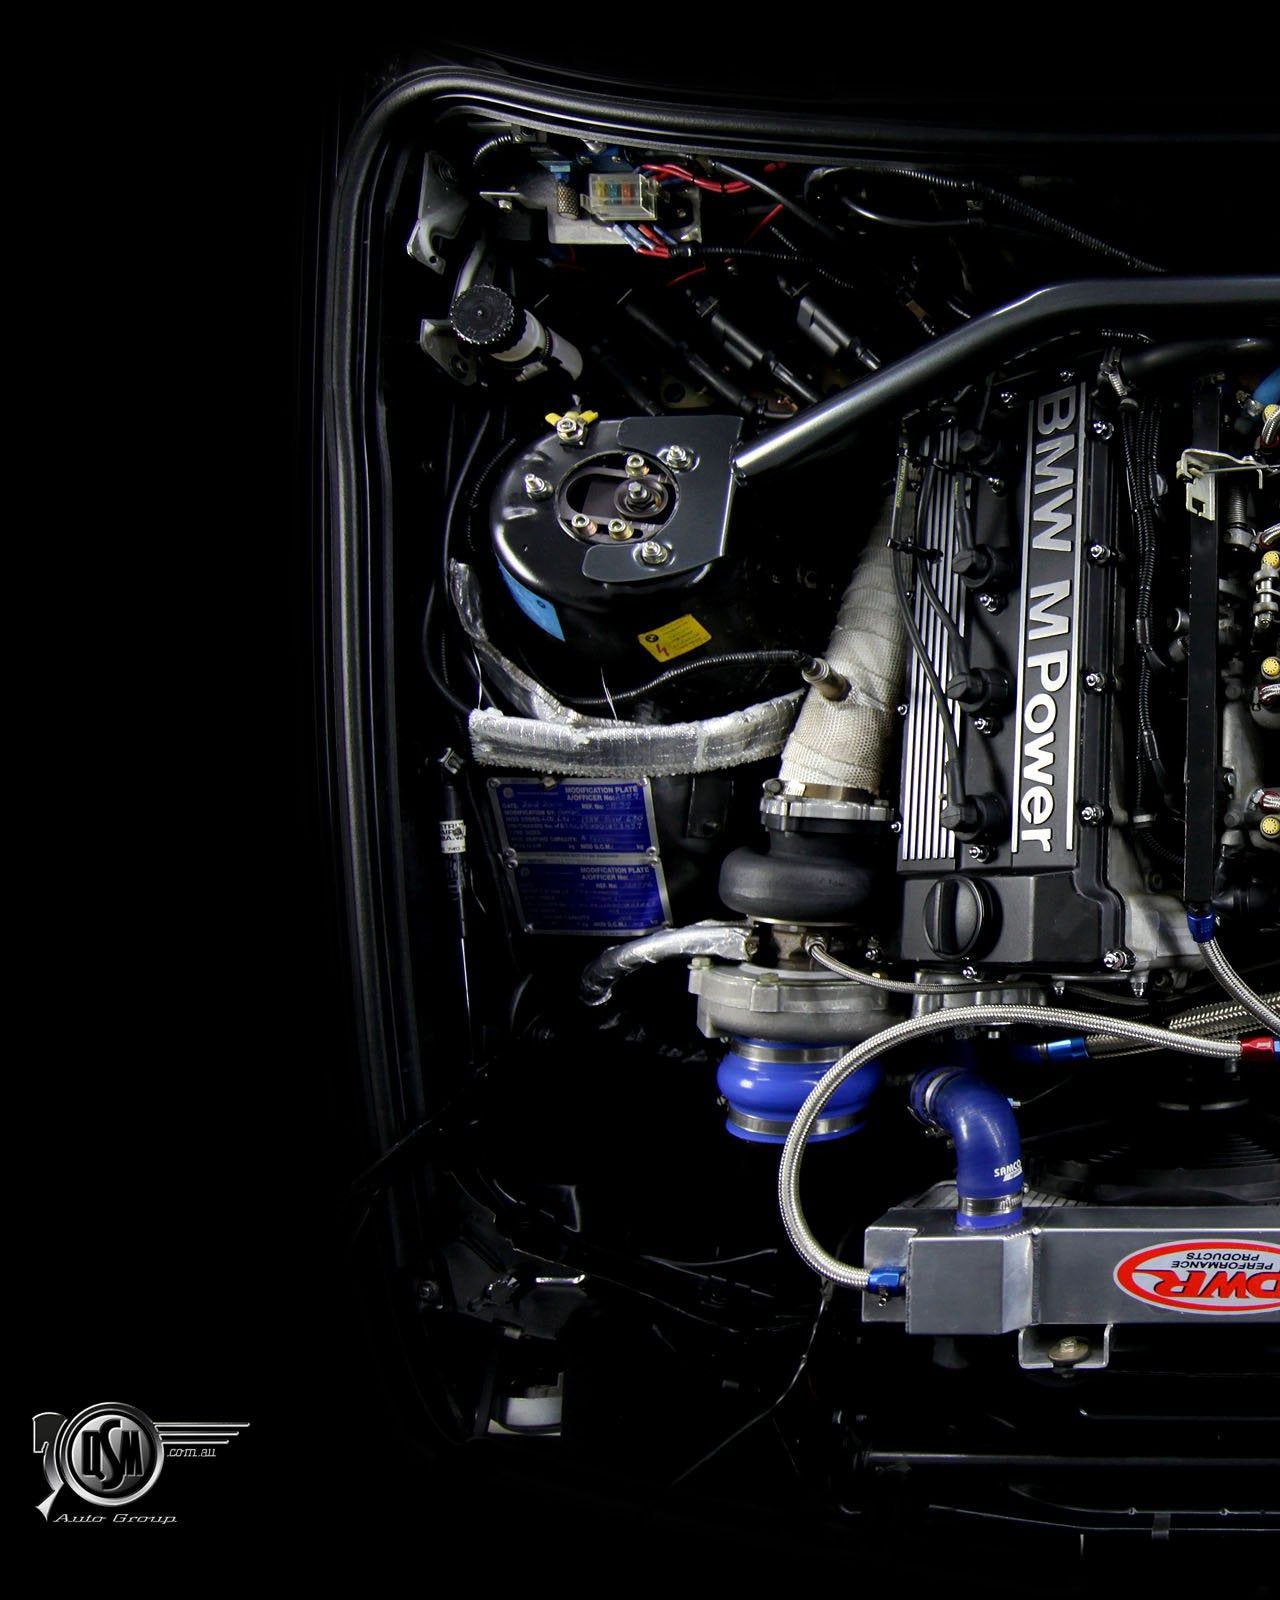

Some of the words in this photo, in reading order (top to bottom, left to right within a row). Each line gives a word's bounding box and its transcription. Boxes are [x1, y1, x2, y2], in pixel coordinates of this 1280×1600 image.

[1032, 387, 1078, 552] BMW
[564, 786, 614, 794] MODIFICATION
[615, 785, 638, 794] PLATE
[580, 866, 627, 874] MODIFICATION
[993, 1159, 1022, 1178] SAMCO
[1186, 1252, 1260, 1262] PRODUCTS
[1171, 1261, 1274, 1270] PERFORMANCE
